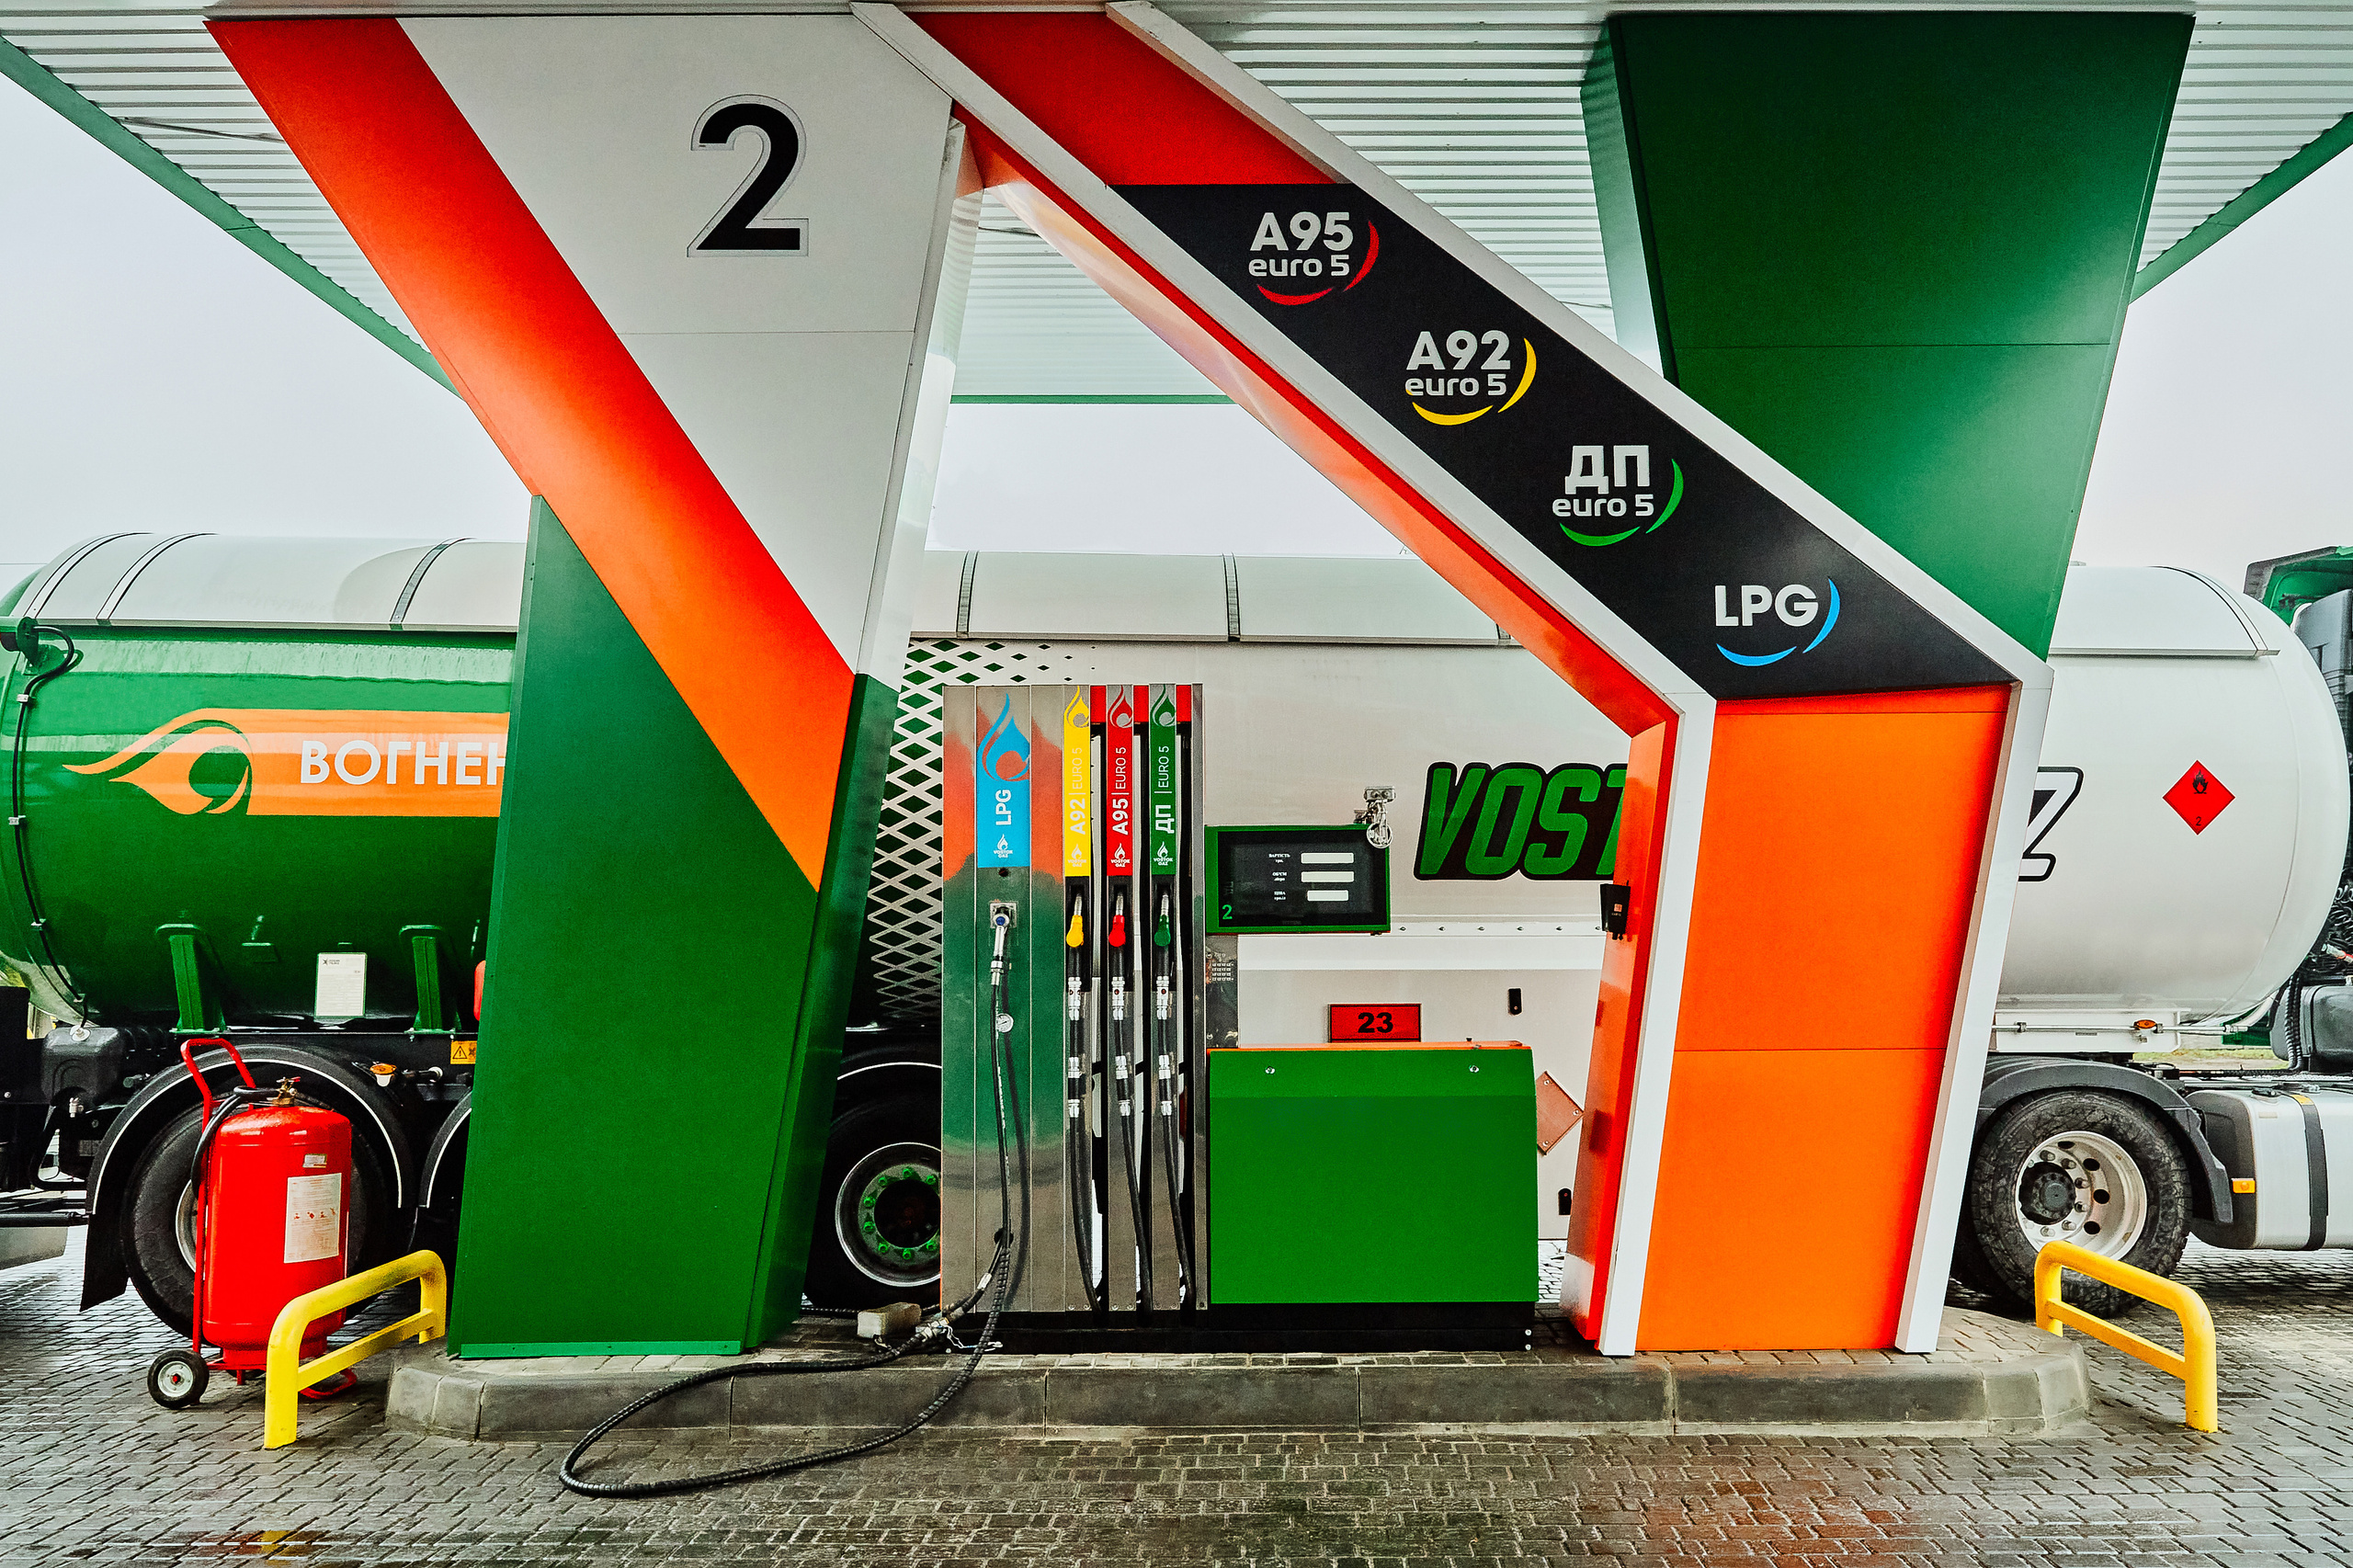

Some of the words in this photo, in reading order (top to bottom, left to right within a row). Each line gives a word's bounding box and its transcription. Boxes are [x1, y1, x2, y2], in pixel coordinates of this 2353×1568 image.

[687, 94, 809, 257] 2
[1249, 211, 1354, 252] A95
[1248, 258, 1323, 277] euro
[1330, 255, 1350, 277] 5
[1405, 329, 1511, 370] A92
[1404, 377, 1480, 396] euro
[1487, 374, 1506, 396] 5
[1564, 445, 1651, 494] ДП
[1552, 498, 1627, 517] euro
[1634, 494, 1654, 517] 5
[1714, 584, 1819, 627] LPG
[1115, 746, 1127, 755] 5
[1158, 745, 1170, 754] 5
[1072, 757, 1083, 790] EURO
[1115, 757, 1127, 790] EURO
[1157, 756, 1169, 788] EURO
[995, 790, 1012, 825] LPG
[1069, 798, 1086, 835] A92
[1112, 798, 1129, 835] A95
[1154, 804, 1175, 834] ДП
[2195, 816, 2202, 826] 2
[1222, 904, 1233, 919] 2
[1358, 1012, 1393, 1033] 23
